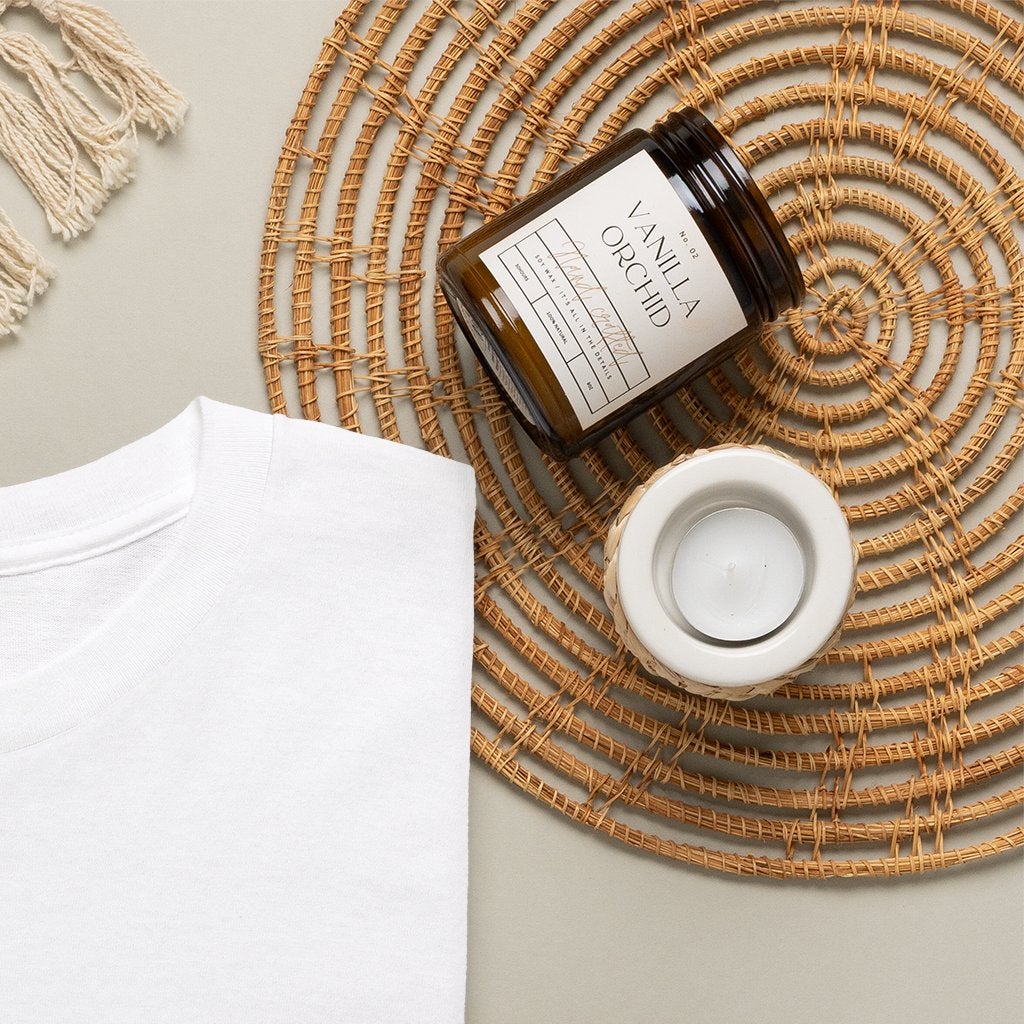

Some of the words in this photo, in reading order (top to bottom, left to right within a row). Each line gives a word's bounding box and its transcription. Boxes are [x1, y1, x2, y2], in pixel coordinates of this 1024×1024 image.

[601, 225, 671, 328] ORCHID
[627, 200, 701, 319] VANILLA
[678, 230, 689, 246] No.
[689, 247, 699, 259] 02
[535, 254, 545, 267] SOY
[544, 268, 556, 283] WAX
[559, 291, 570, 306] IT'S
[569, 308, 580, 323] ALL
[579, 324, 587, 334] IN
[585, 335, 597, 350] THE
[594, 351, 613, 381] DETAILS
